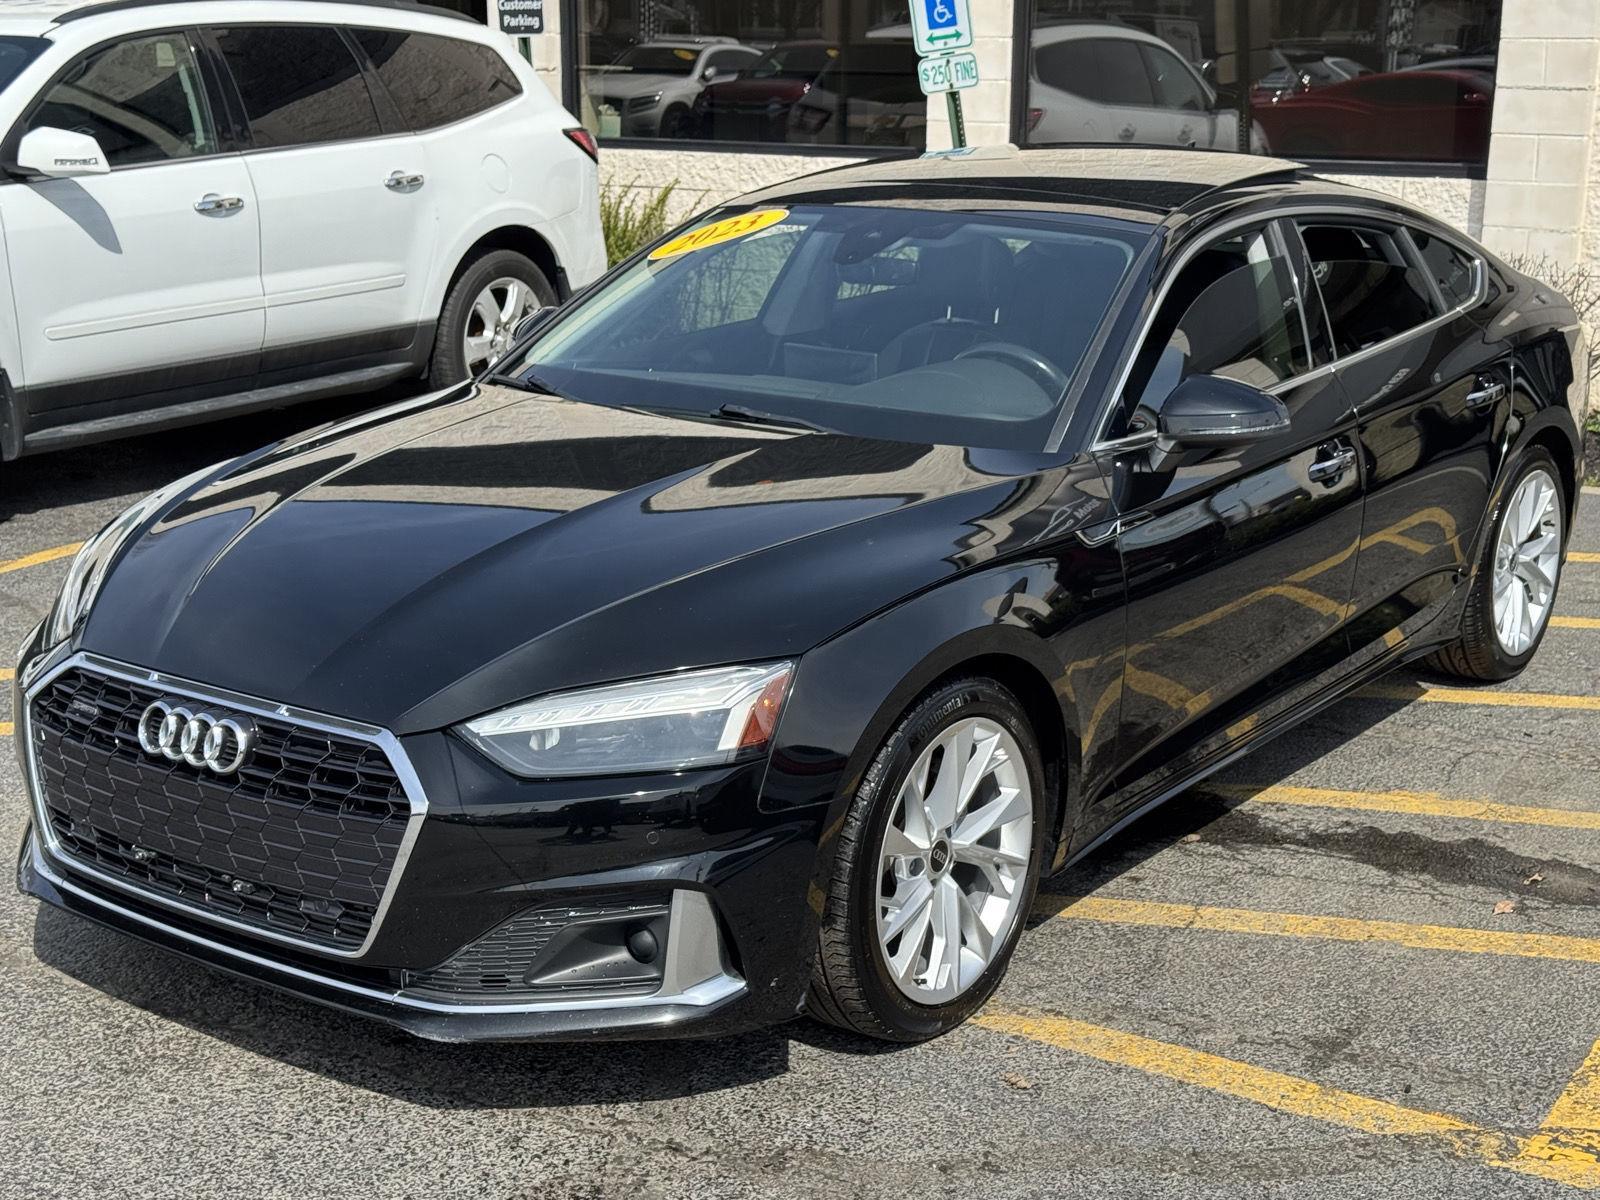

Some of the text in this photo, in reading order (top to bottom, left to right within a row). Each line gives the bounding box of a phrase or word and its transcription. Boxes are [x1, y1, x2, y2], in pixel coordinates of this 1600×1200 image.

[499, 0, 542, 10] Customer
[503, 14, 540, 29] Parking
[954, 60, 977, 82] FINE
[667, 214, 764, 254] 2023
